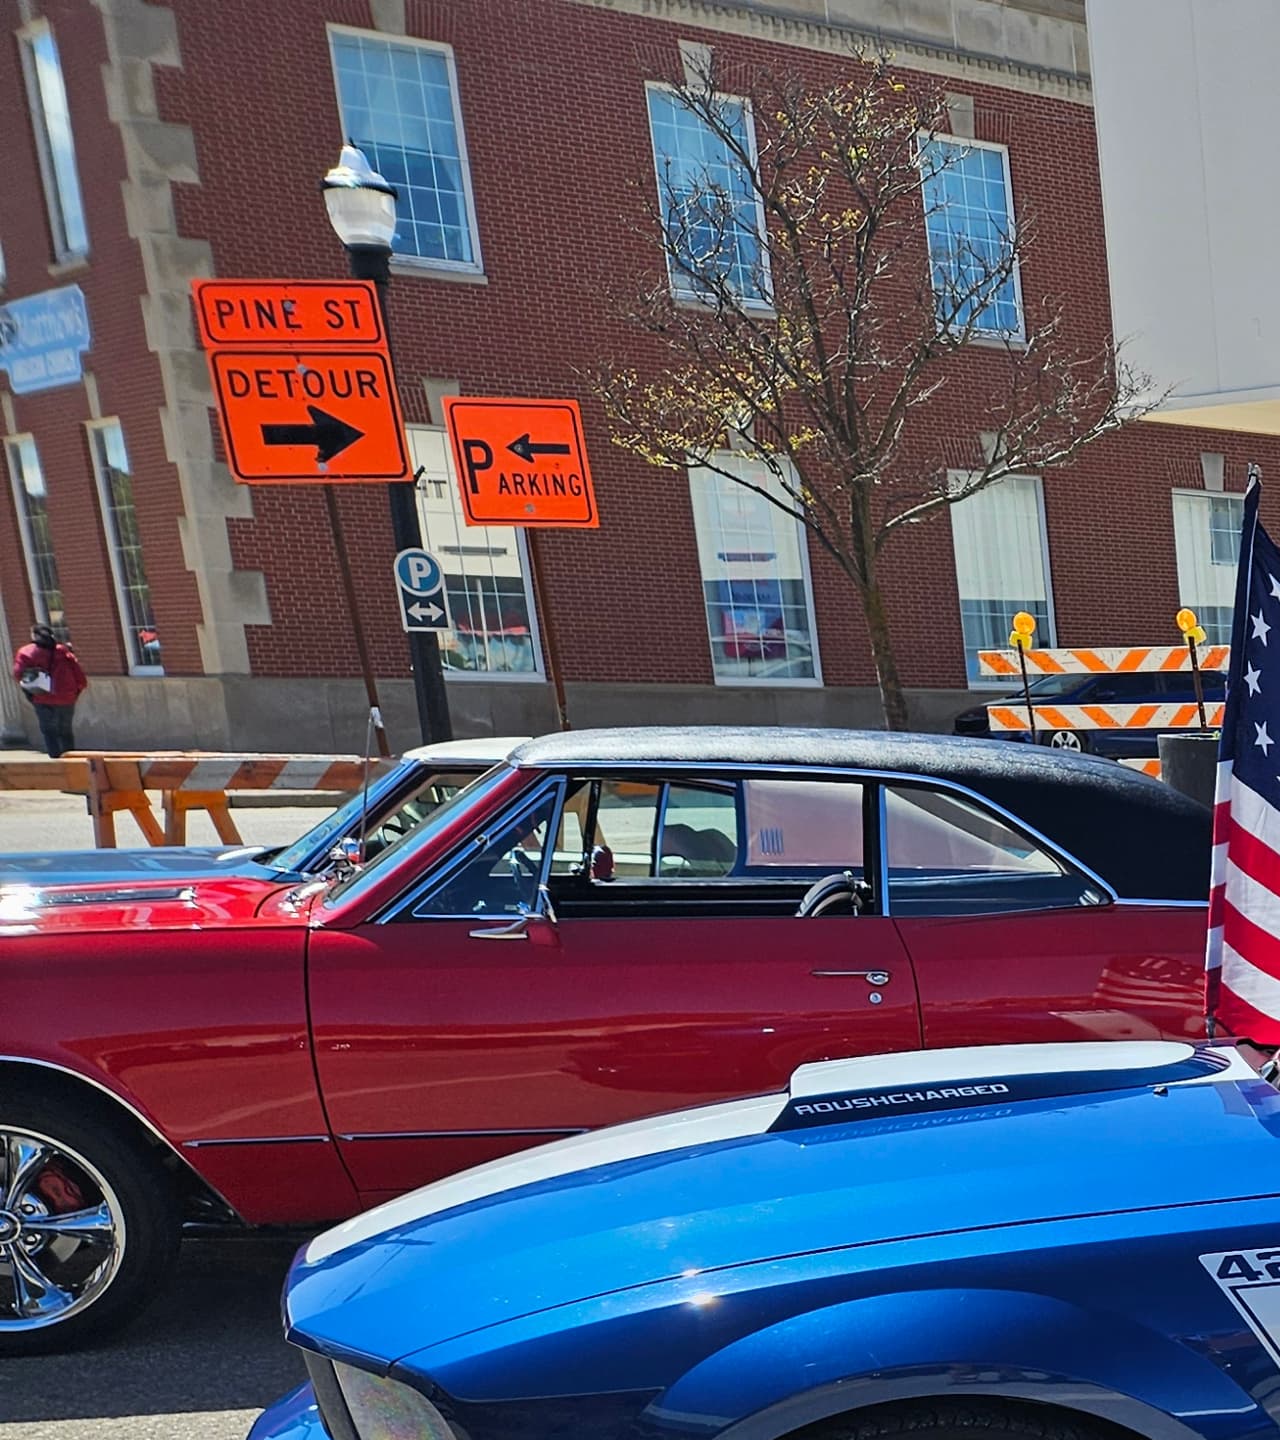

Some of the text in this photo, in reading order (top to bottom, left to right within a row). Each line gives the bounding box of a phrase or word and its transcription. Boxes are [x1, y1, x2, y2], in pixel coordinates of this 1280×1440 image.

[215, 299, 360, 329] PINE ST
[227, 369, 381, 399] DETOUR
[462, 439, 582, 496] PARKING
[408, 557, 432, 589] P
[794, 1083, 1010, 1115] ROUSHCHARGED
